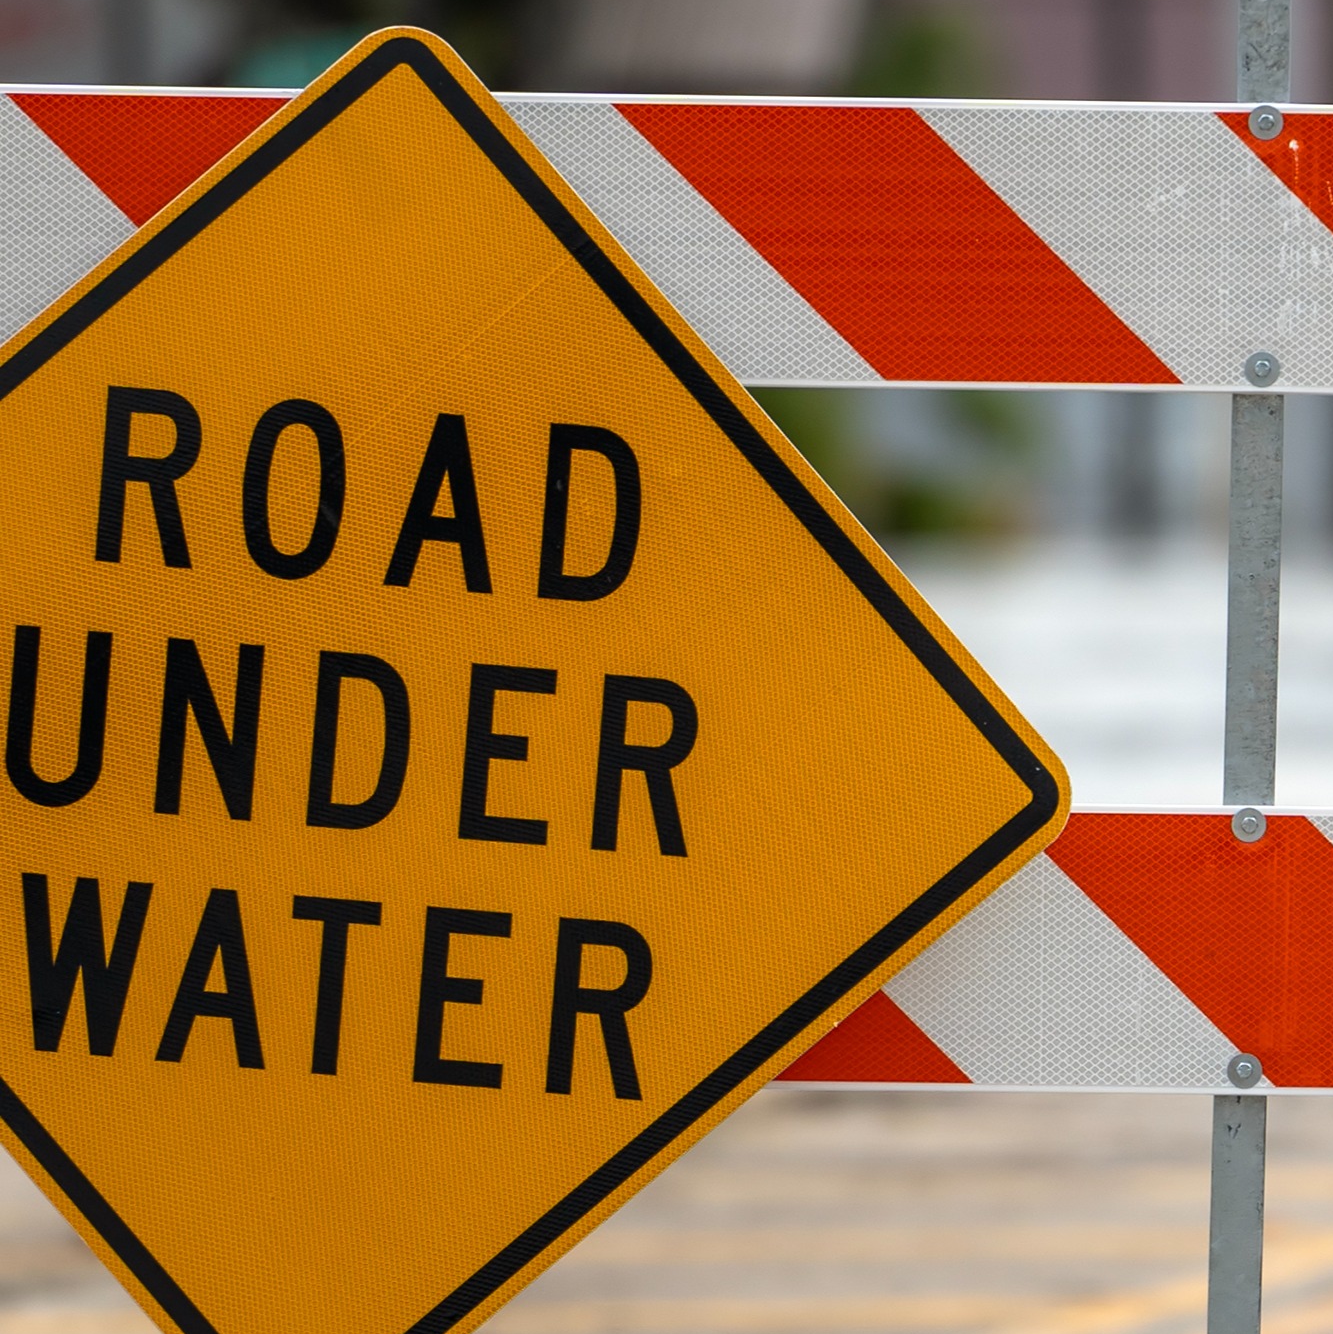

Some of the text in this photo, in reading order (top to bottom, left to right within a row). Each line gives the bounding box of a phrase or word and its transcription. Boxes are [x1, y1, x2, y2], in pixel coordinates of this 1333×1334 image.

[94, 385, 642, 602] ROAD
[4, 624, 699, 858] UNDER
[21, 872, 653, 1101] WATER
